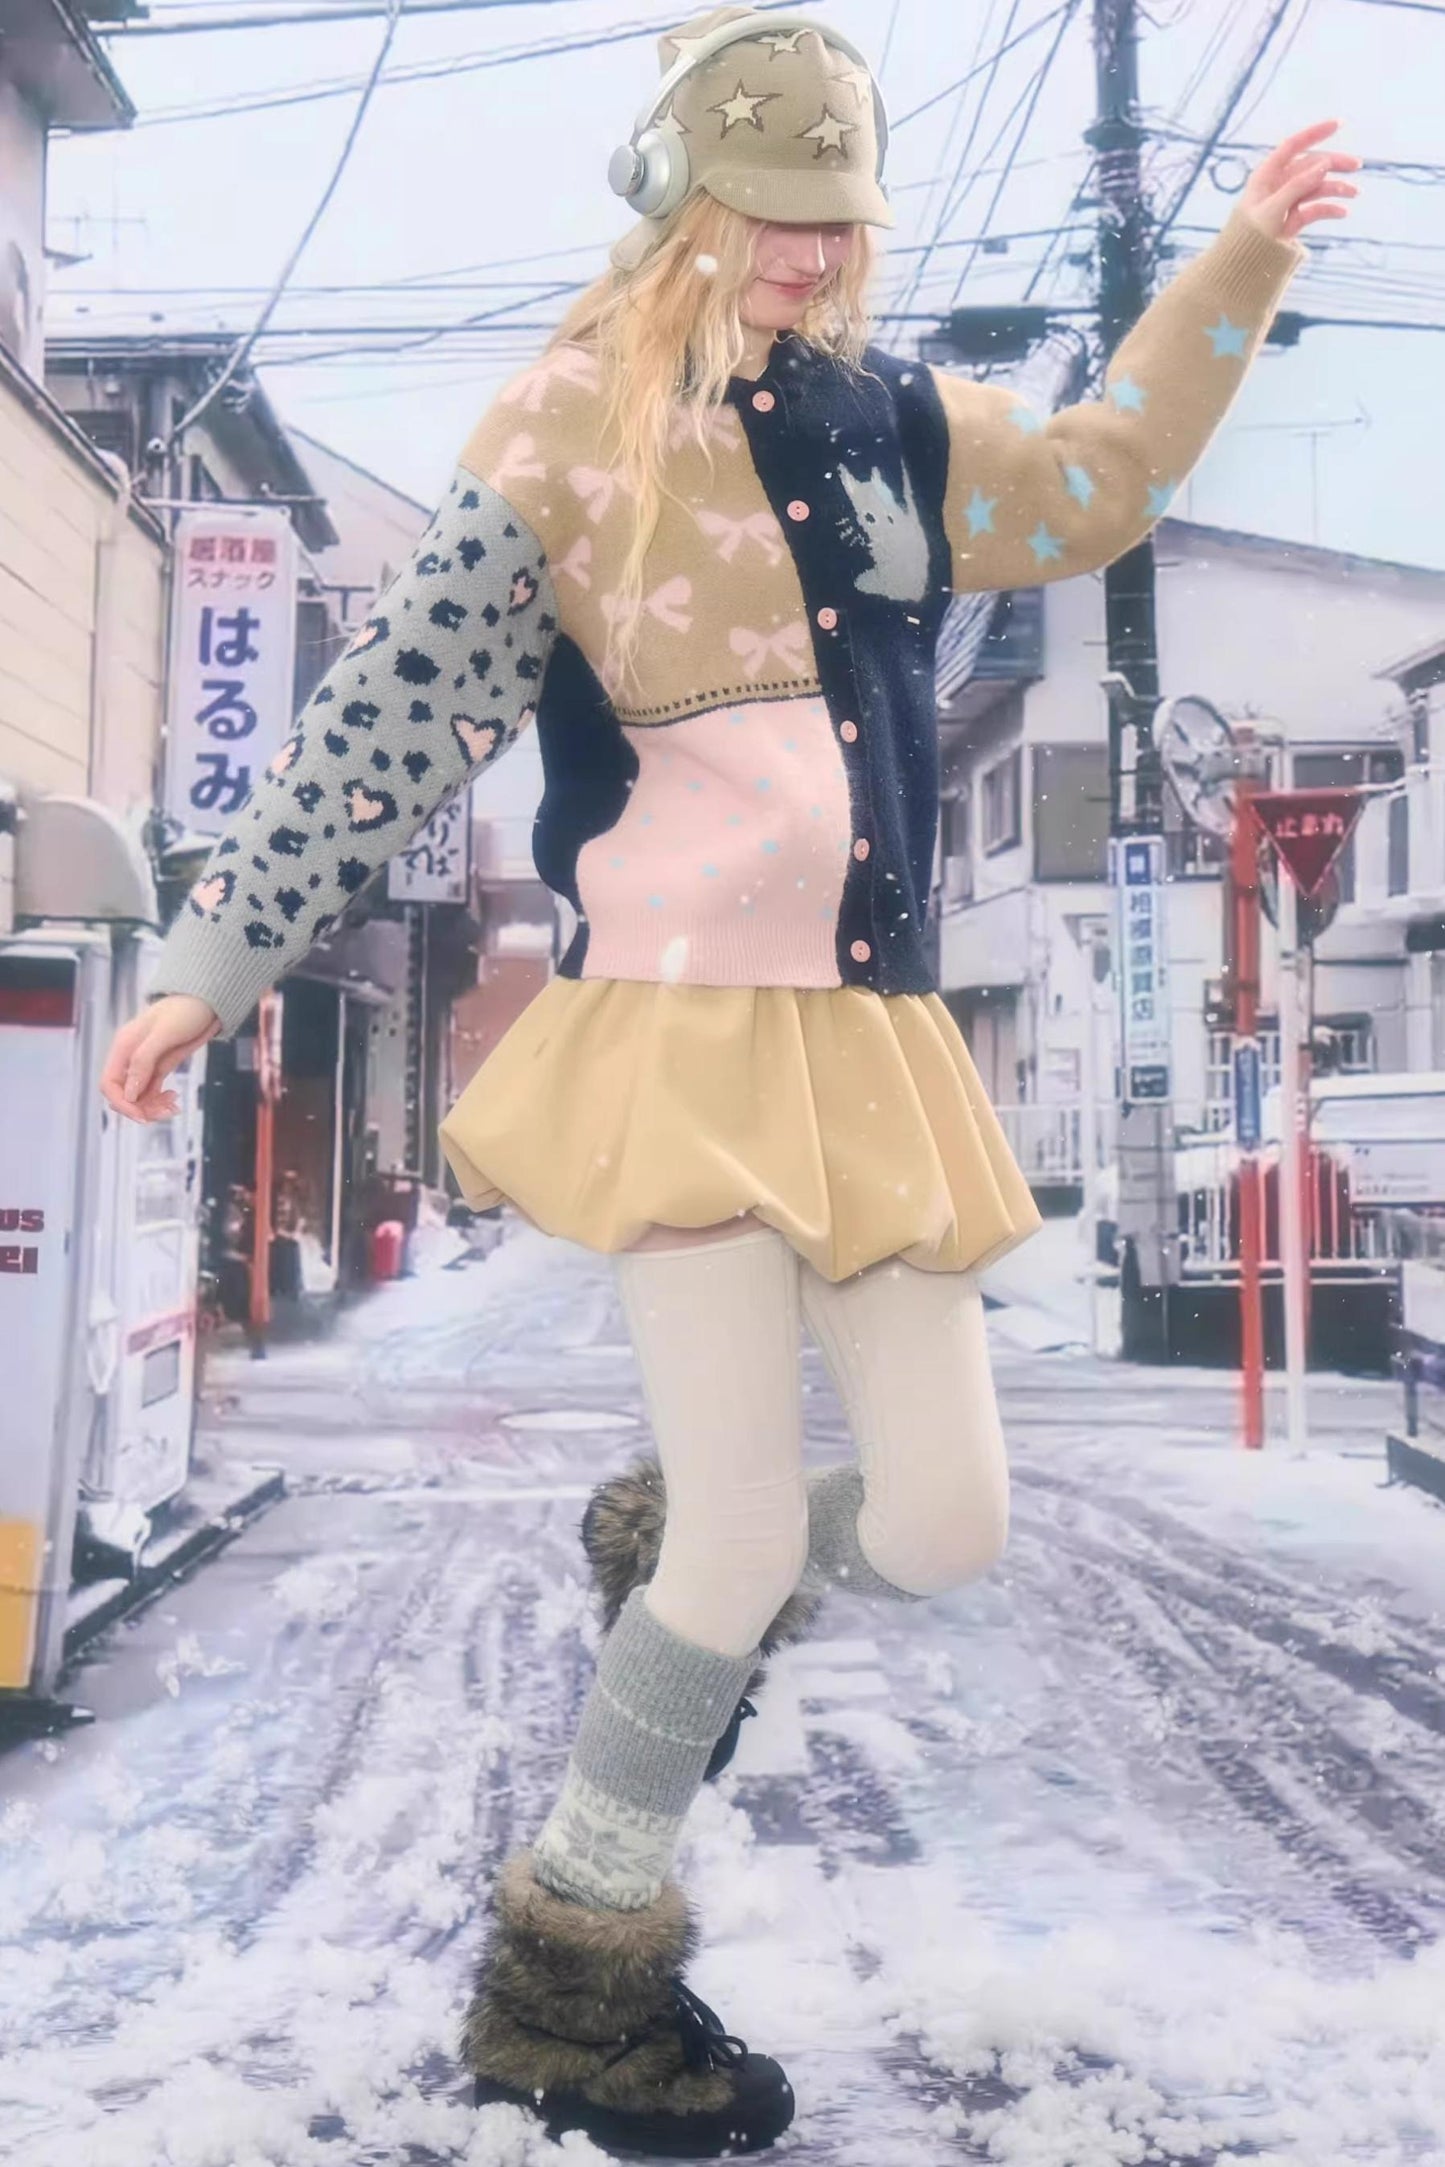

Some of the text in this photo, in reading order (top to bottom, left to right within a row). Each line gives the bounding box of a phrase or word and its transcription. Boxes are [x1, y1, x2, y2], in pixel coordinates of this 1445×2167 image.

[187, 567, 275, 590] スナック
[190, 606, 260, 815] はるみ
